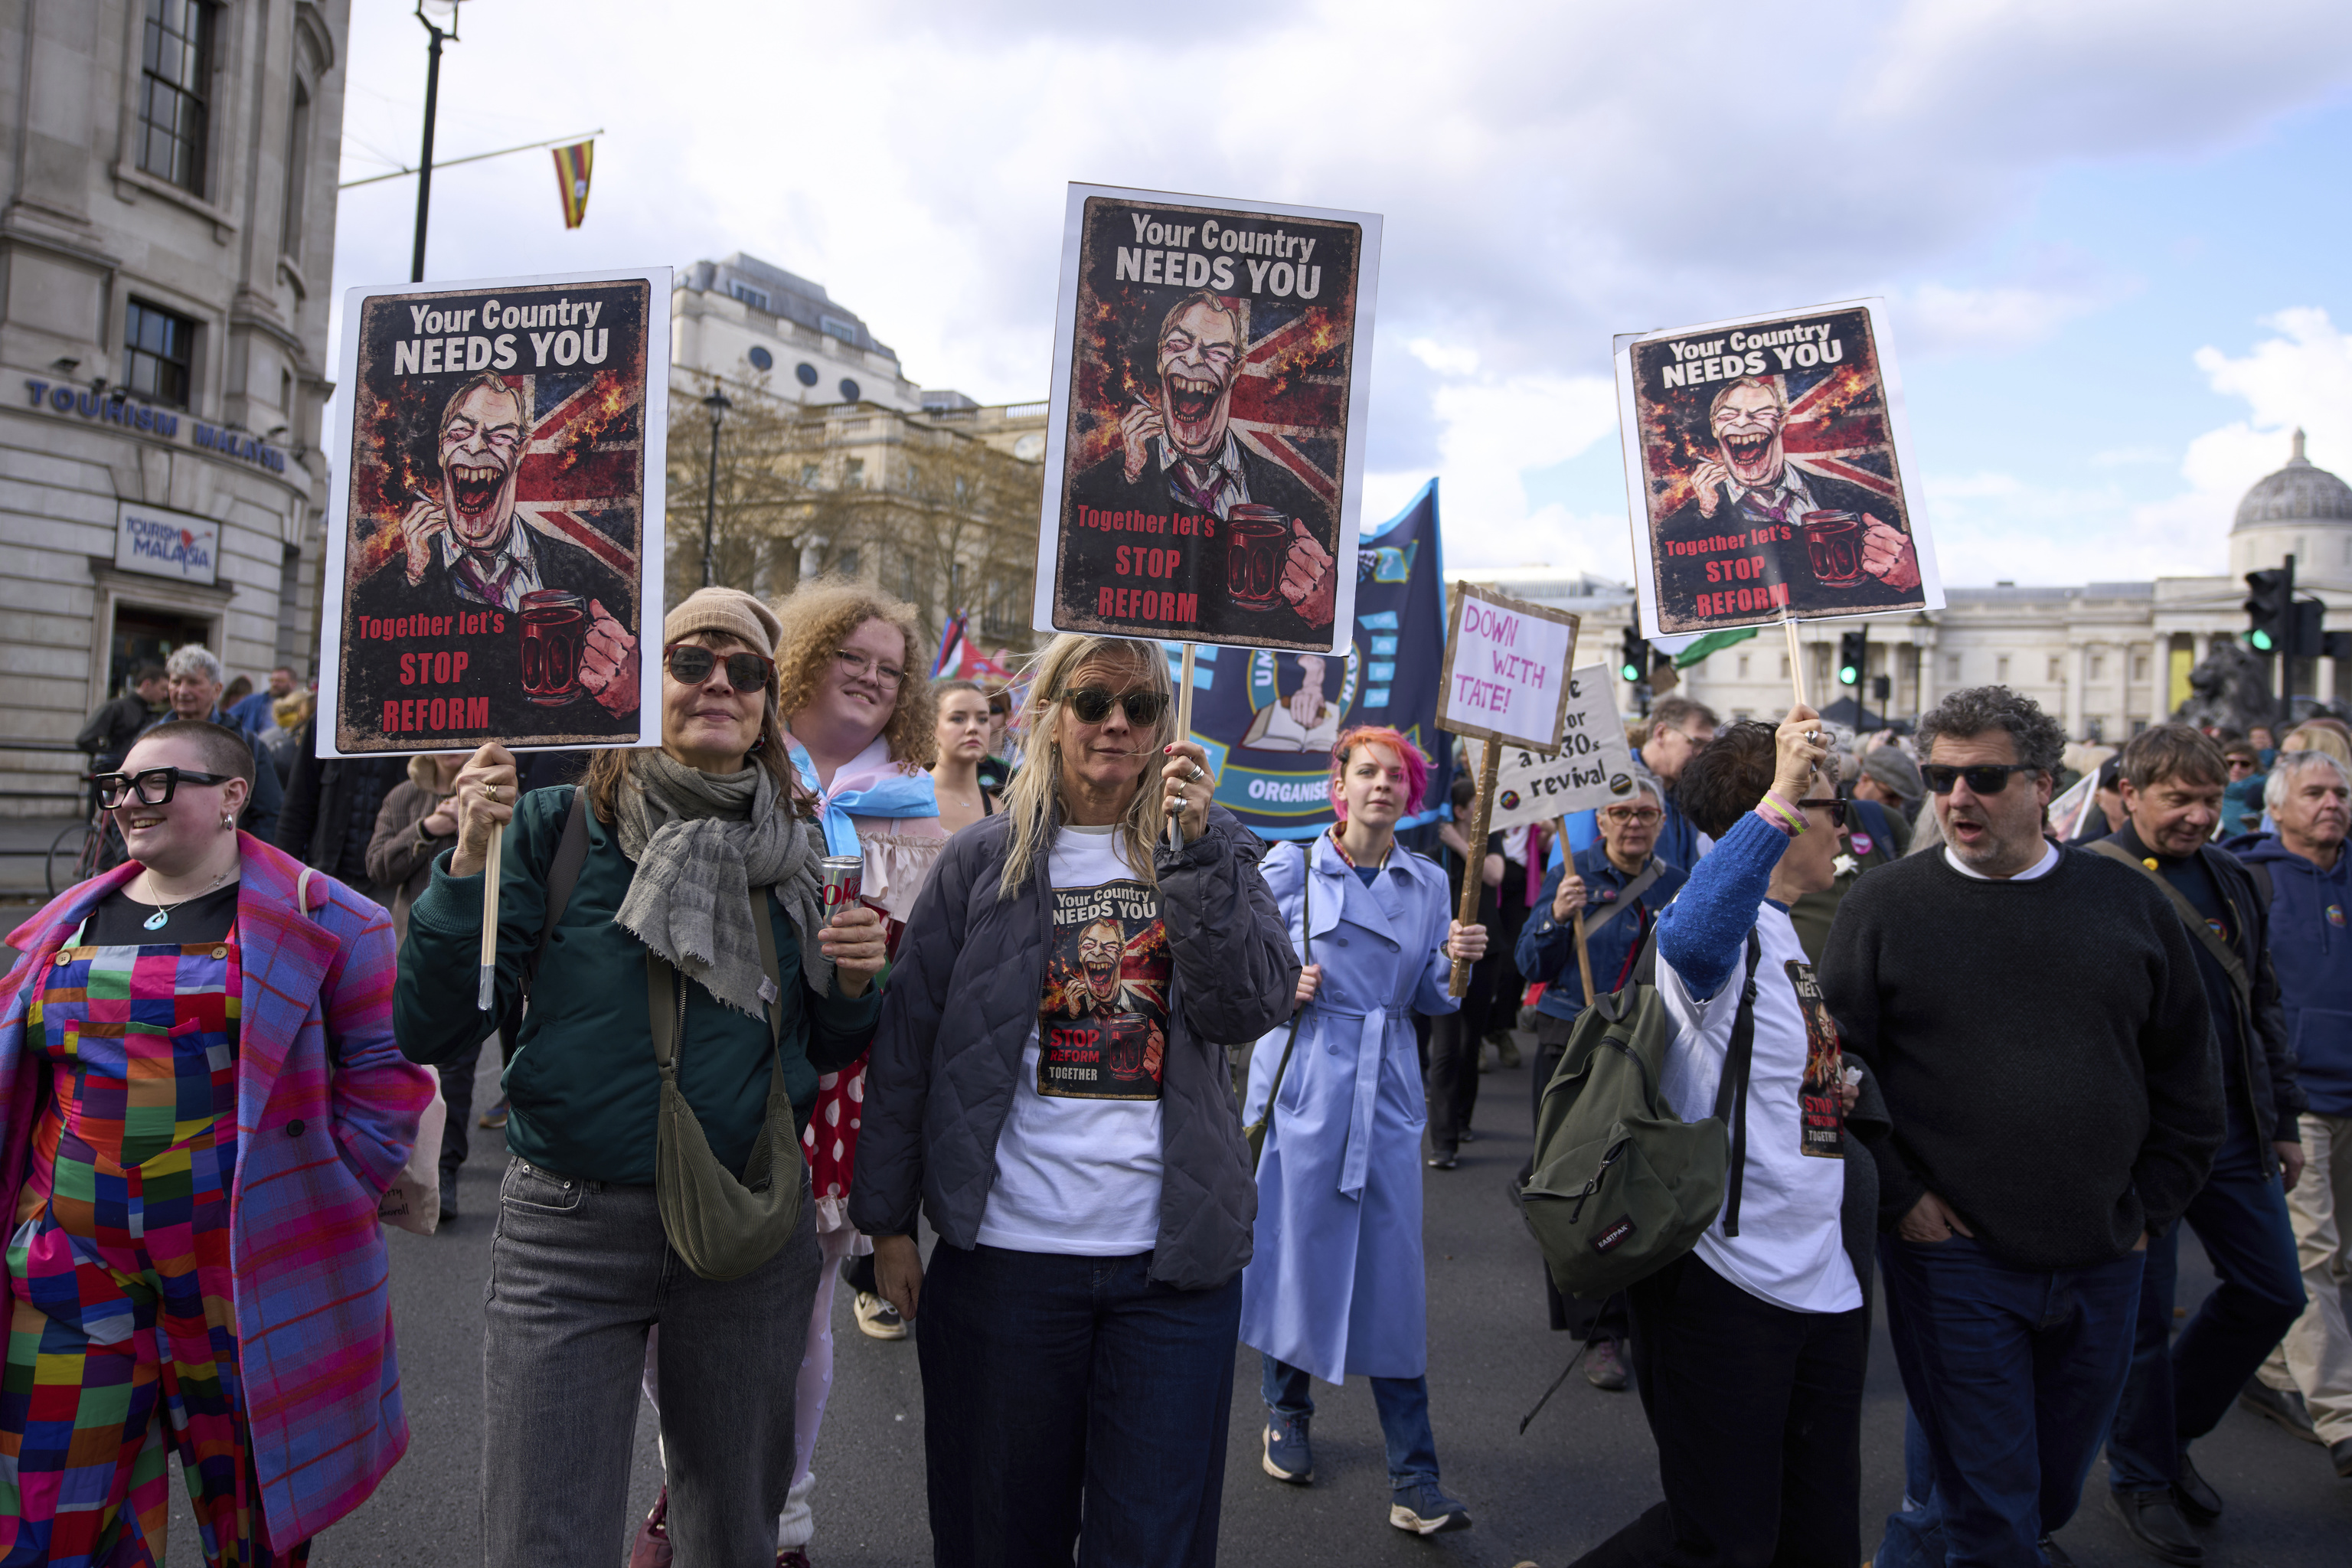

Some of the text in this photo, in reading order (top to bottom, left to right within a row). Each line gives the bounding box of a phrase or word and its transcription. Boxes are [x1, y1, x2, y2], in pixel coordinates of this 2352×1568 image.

[1131, 212, 1316, 263] Your Country
[1116, 246, 1321, 299] NEEDS YOU
[410, 298, 603, 335] Your Country
[394, 328, 609, 375] NEEDS YOU
[1669, 322, 1831, 362] Your Country
[1661, 338, 1844, 390] NEEDS YOU
[26, 380, 286, 474] TOURISM MALAYSIA
[126, 516, 182, 542] TOURISM
[1077, 505, 1215, 538] Together let's
[132, 537, 211, 574] MALAYSIA
[1664, 524, 1792, 557] Together let's
[1115, 545, 1181, 579] STOP
[1705, 555, 1766, 583] STOP
[1098, 586, 1198, 623] REFORM
[1696, 583, 1790, 618] REFORM
[359, 609, 505, 641] Together let's
[1464, 605, 1519, 647] DOWN
[400, 651, 469, 685] STOP
[1493, 650, 1546, 689] WITH
[1455, 673, 1511, 714] TATE!
[383, 697, 489, 732] REFORM
[1564, 711, 1586, 729] or
[1518, 751, 1532, 768] a
[1530, 758, 1606, 798] revival
[822, 875, 861, 905] oke
[1056, 893, 1091, 908] Your
[1053, 900, 1157, 926] NEEDS YOU
[1050, 1029, 1100, 1048] STOP
[1050, 1049, 1099, 1063] REFORM
[1049, 1067, 1098, 1081] TOGETHER
[1805, 1096, 1833, 1114] STOP
[1598, 1224, 1628, 1248] EASTPAK
